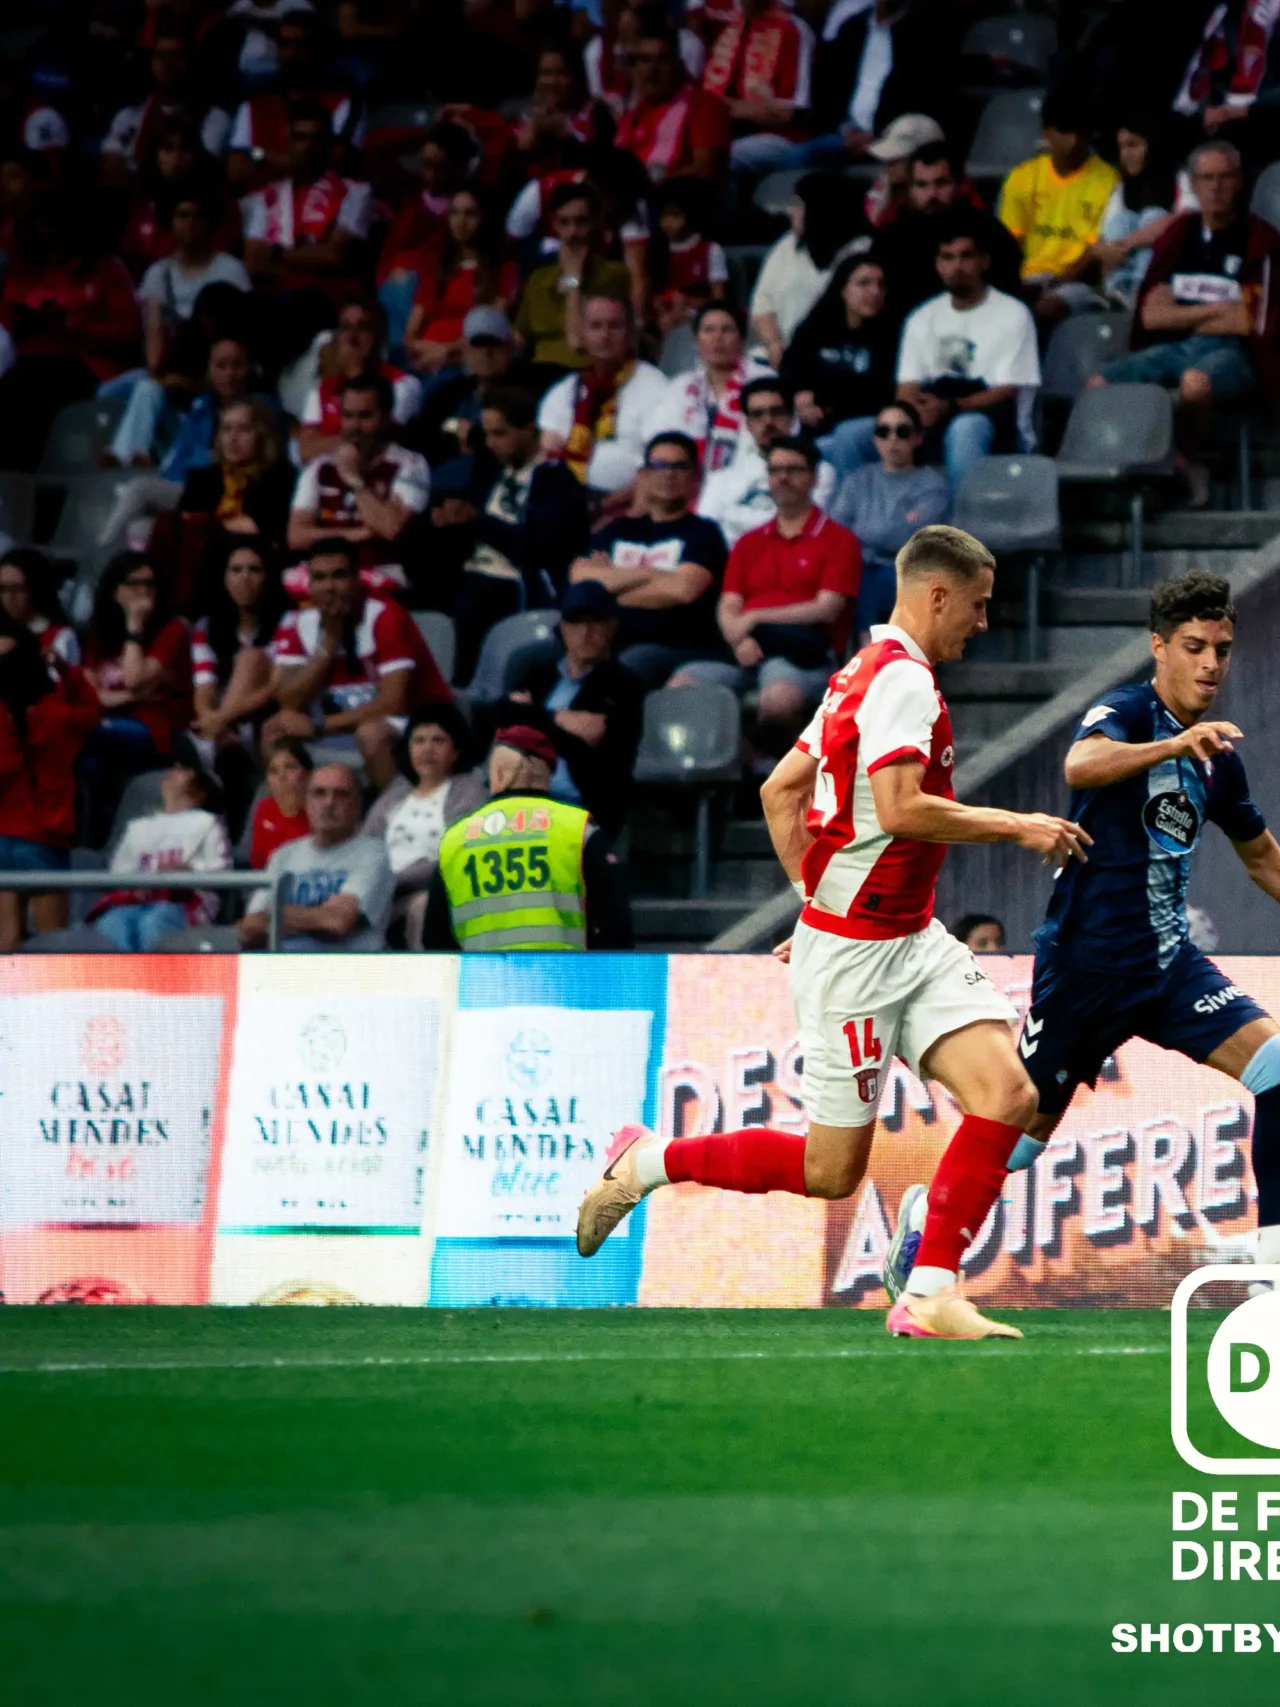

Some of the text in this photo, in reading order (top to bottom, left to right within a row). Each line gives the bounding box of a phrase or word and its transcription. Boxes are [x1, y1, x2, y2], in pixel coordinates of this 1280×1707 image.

[1155, 813, 1187, 842] Galicia
[1157, 798, 1193, 830] Estrella
[464, 846, 551, 897] 1355
[842, 1017, 882, 1067] 14
